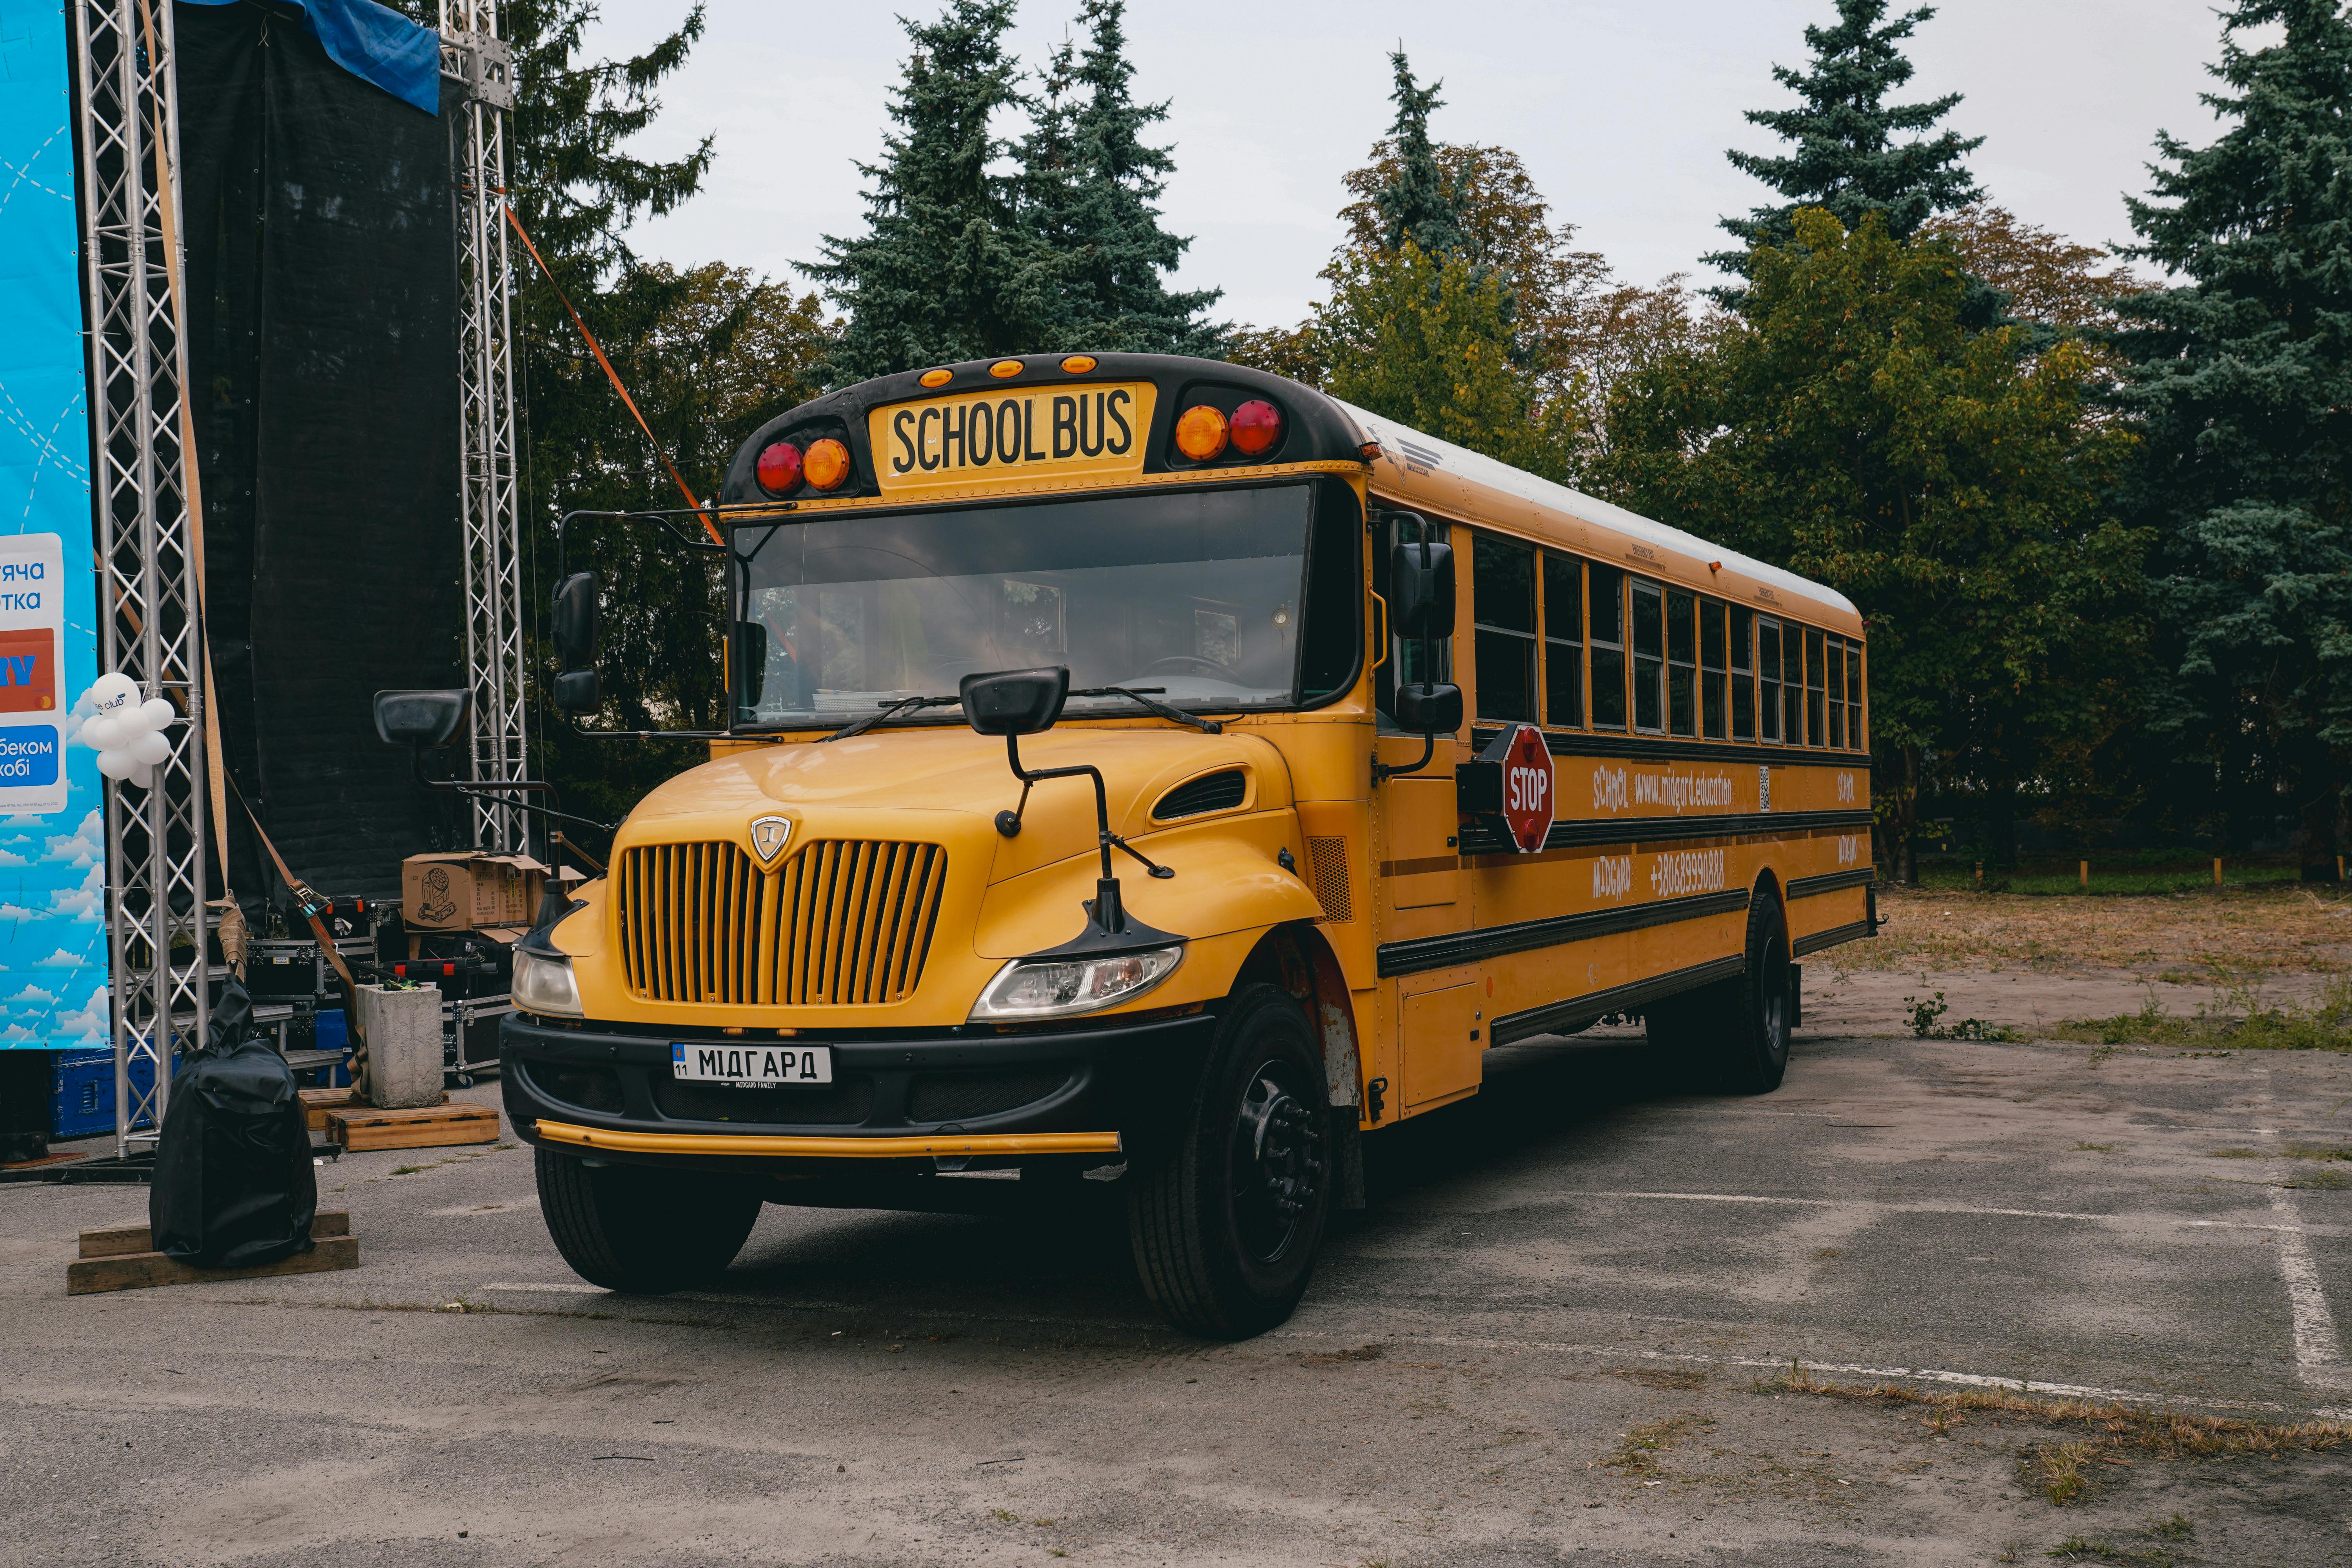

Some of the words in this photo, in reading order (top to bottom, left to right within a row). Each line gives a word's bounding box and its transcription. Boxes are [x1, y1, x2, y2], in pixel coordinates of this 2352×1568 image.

[893, 399, 1045, 473] SCHOOL
[1053, 389, 1132, 459] BUS
[0, 563, 44, 581] яча
[0, 593, 40, 610] тка
[105, 698, 123, 709] club
[1511, 767, 1547, 812] STOP
[1593, 765, 1628, 812] SCHOOL
[1635, 767, 1732, 814] www.midgard.education
[1838, 771, 1855, 804] SCHOOL
[1838, 835, 1857, 866] MIDGARD
[1593, 855, 1630, 901] MIDGARD
[1651, 849, 1724, 897] +380689990888
[675, 1064, 687, 1075] 11
[699, 1049, 817, 1079] МІДГАРД
